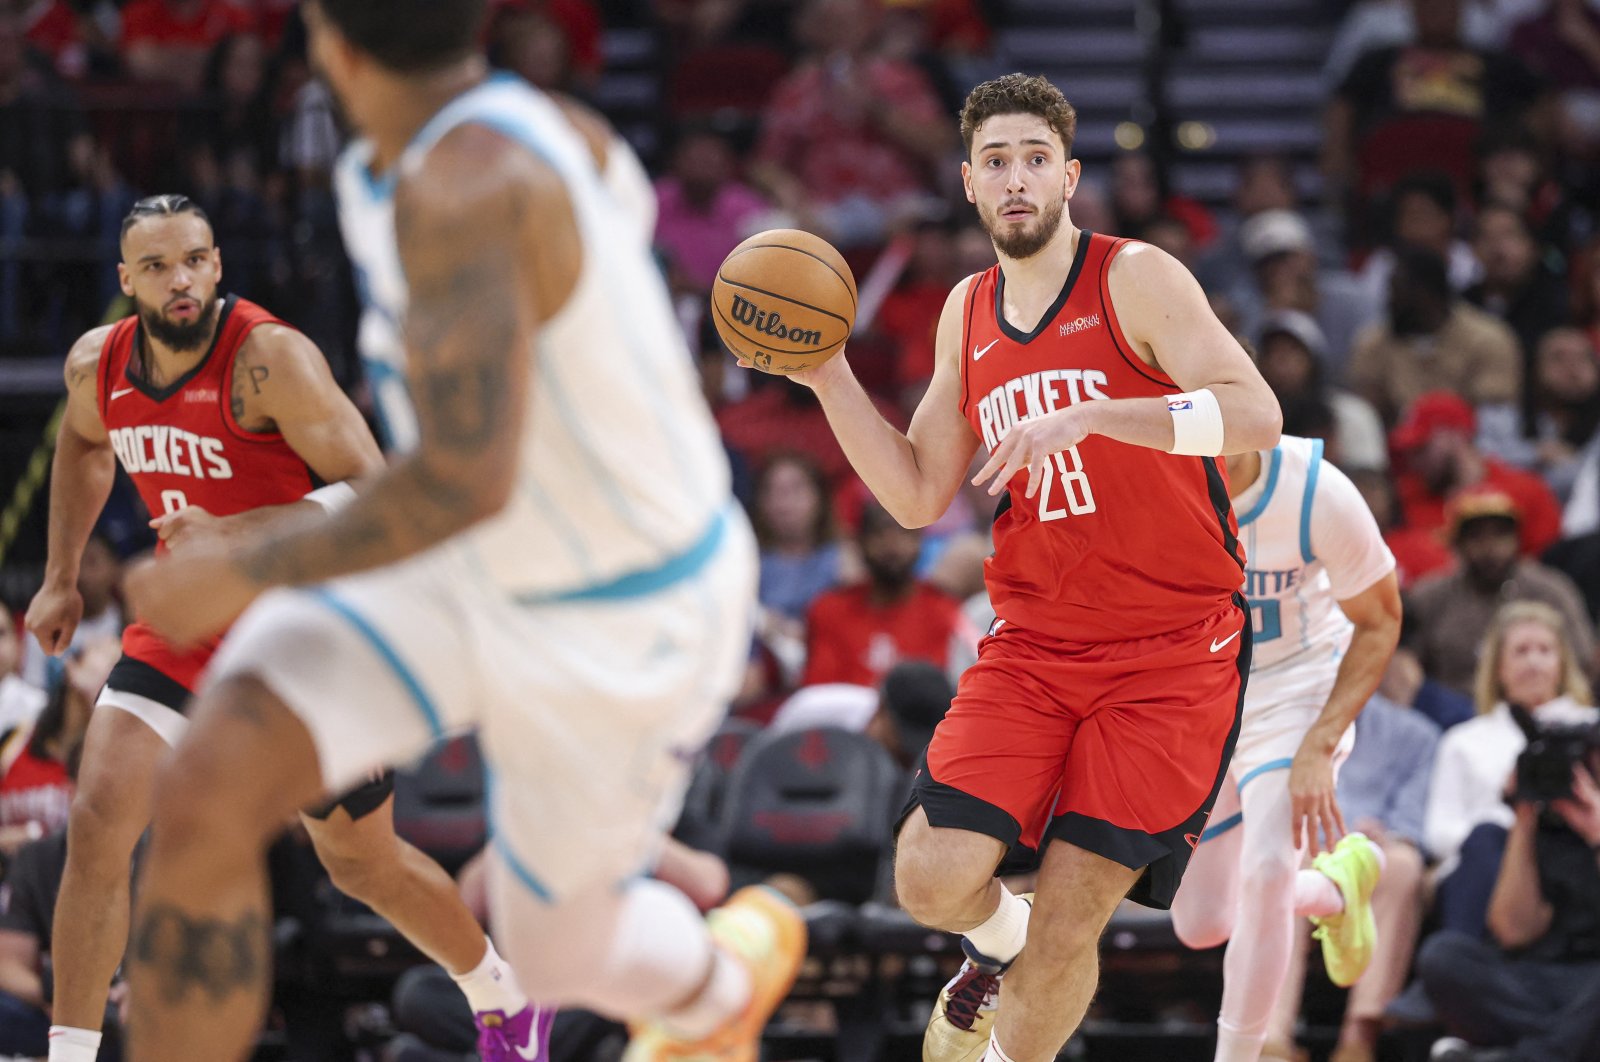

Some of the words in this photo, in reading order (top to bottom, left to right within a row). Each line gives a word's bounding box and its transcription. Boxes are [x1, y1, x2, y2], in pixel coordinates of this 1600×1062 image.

[731, 293, 821, 346] Wilson
[1059, 313, 1100, 332] MEMORIAL
[1059, 317, 1100, 337] HERMANN
[976, 368, 1112, 455] ROCKETS
[108, 424, 234, 480] ROCKETS
